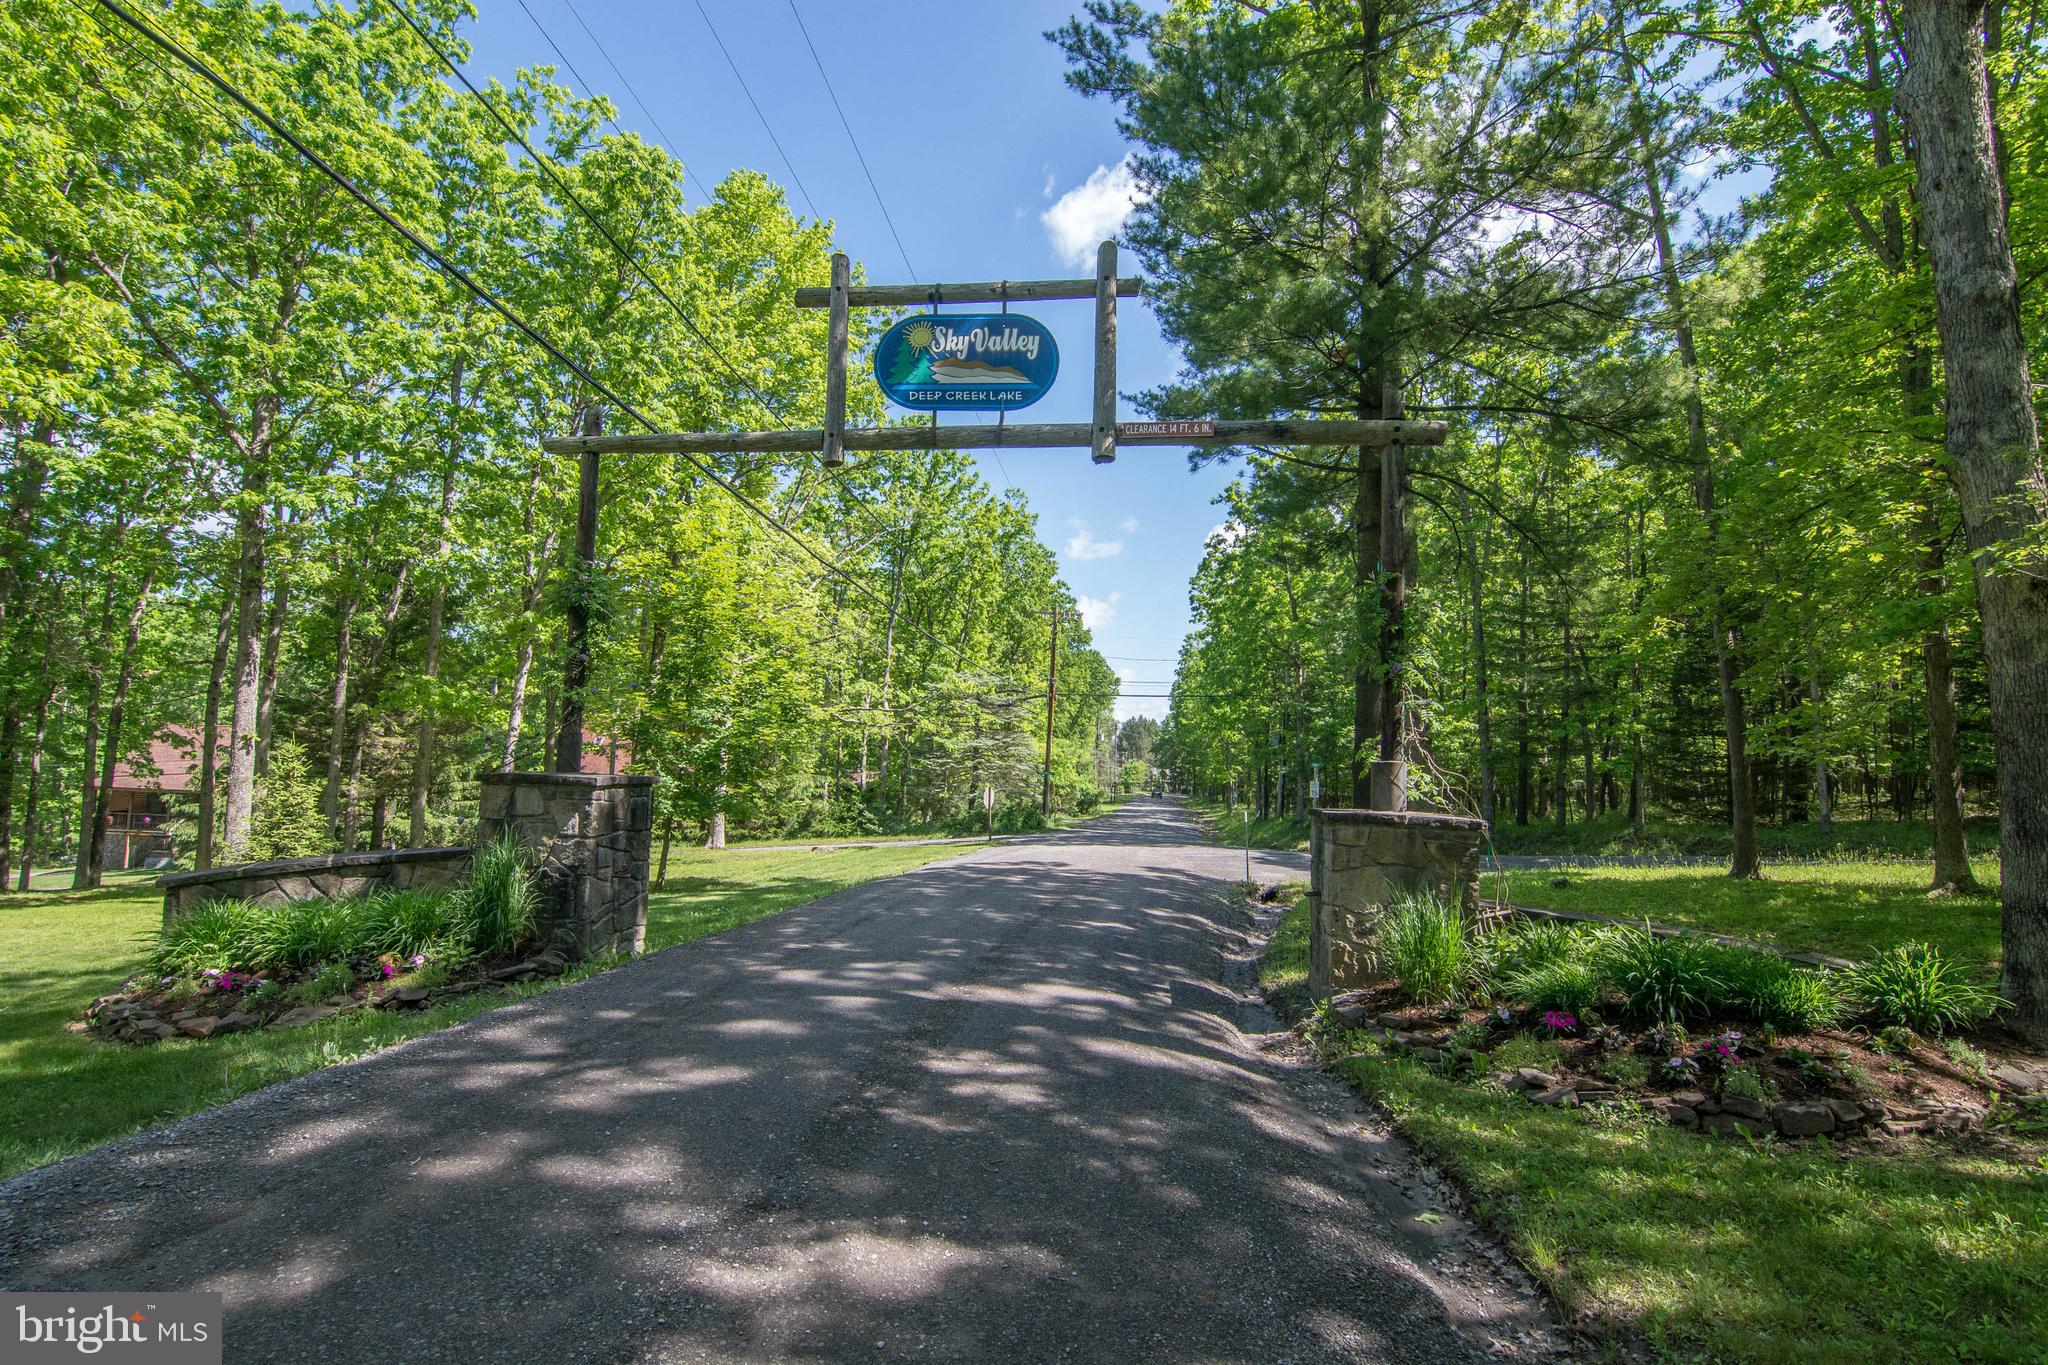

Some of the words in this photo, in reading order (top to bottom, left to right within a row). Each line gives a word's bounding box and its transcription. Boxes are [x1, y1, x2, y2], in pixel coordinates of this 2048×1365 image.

[932, 326, 968, 360] Sky
[970, 327, 1040, 360] Valley
[909, 391, 942, 400] DEEP
[945, 391, 987, 400] CREEK
[989, 391, 1022, 400] LAKE
[1125, 424, 1167, 434] CLEARANCE
[1169, 424, 1177, 433] 14
[1179, 424, 1191, 433] FT.
[1193, 424, 1200, 433] 6
[1201, 423, 1212, 432] IN.
